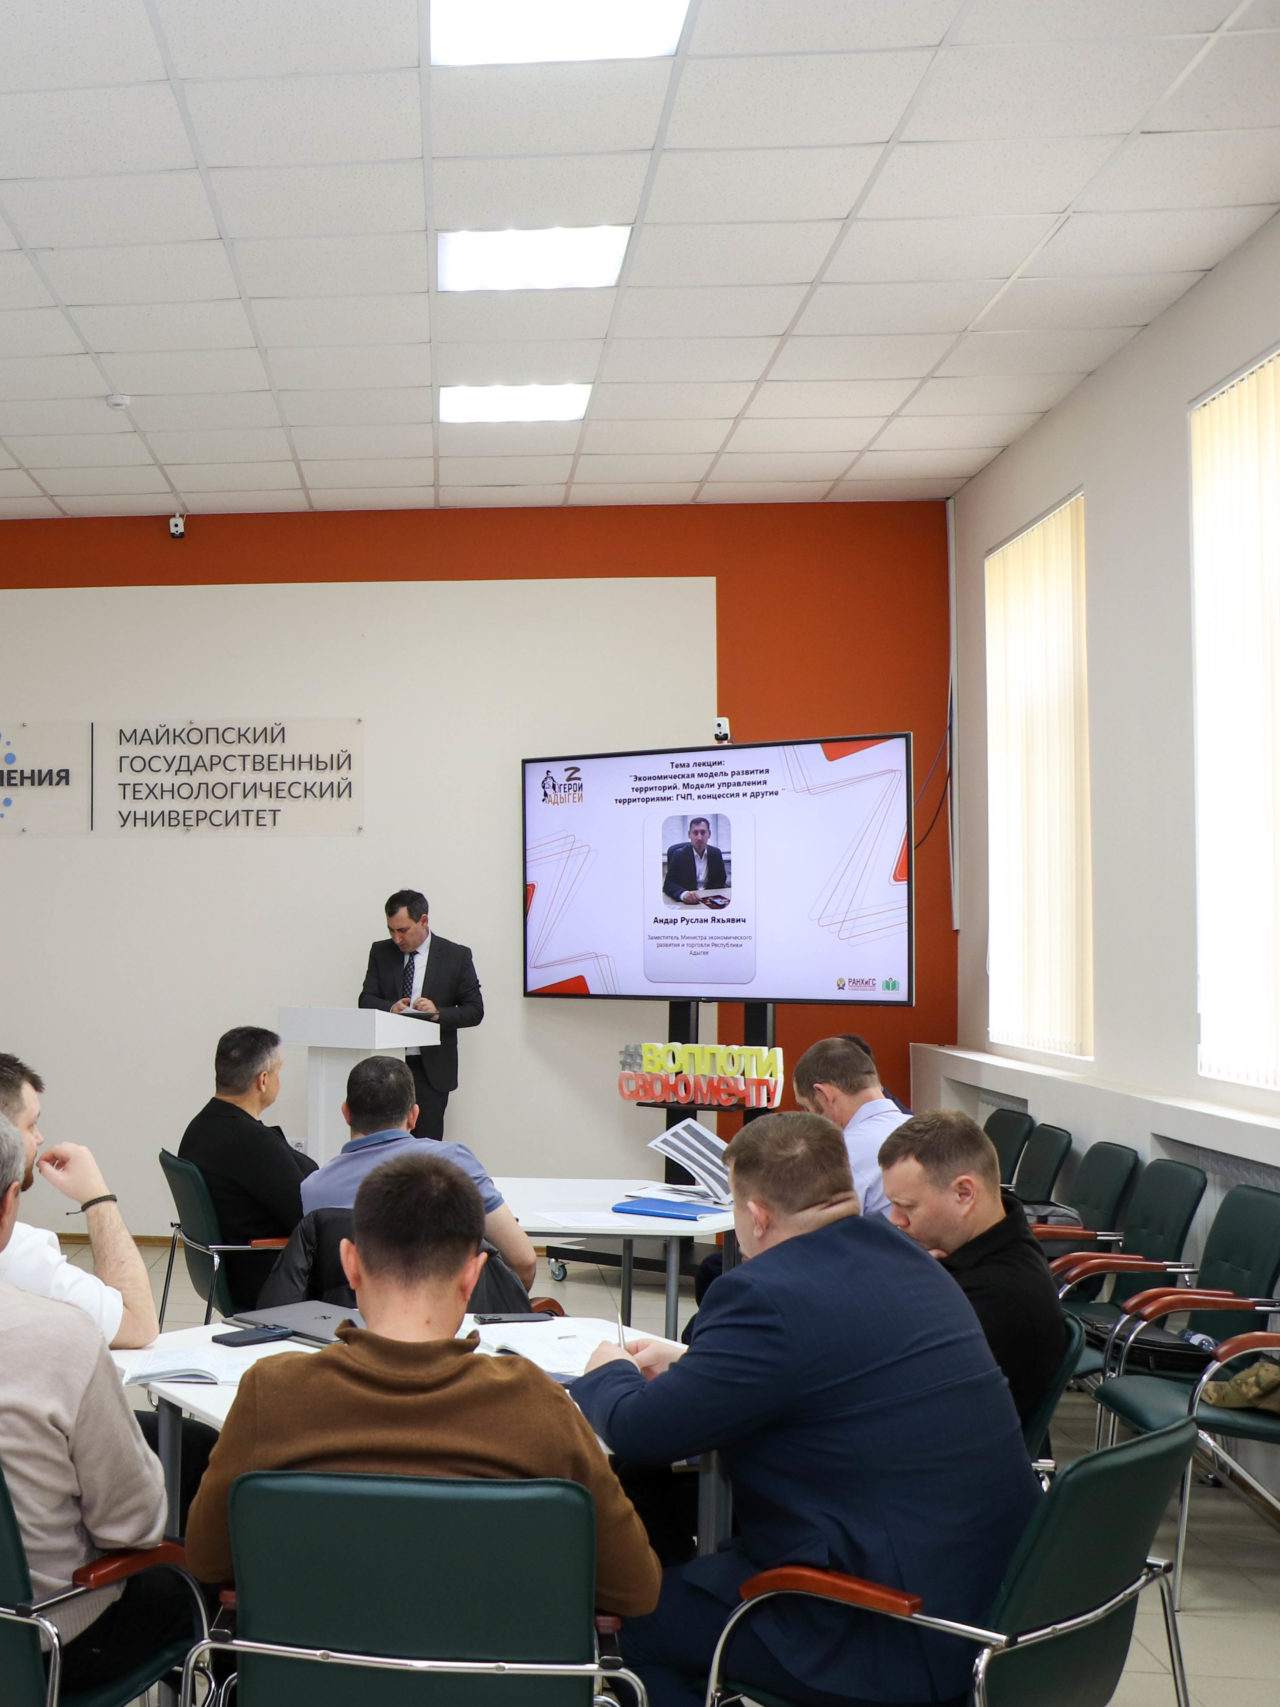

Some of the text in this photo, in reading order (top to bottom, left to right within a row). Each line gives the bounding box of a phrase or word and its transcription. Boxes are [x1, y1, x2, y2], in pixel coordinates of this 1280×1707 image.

[118, 723, 287, 746] МАЙКОПСКИЙ
[118, 751, 353, 776] ГОСУДАРСТВЕННЫЙ
[670, 759, 725, 769] Тема лекции:
[697, 771, 729, 779] модель
[731, 768, 769, 777] развития
[118, 777, 354, 801] ТЕХНОЛОГИЧЕСКИЙ
[682, 782, 715, 791] Модели
[717, 779, 767, 789] управления
[615, 795, 674, 805] территориями:
[697, 791, 739, 800] концессия
[749, 789, 779, 799] другие
[117, 809, 282, 829] УНИВЕРСИТЕТ
[653, 917, 678, 925] Андар
[680, 917, 708, 925] Руслан
